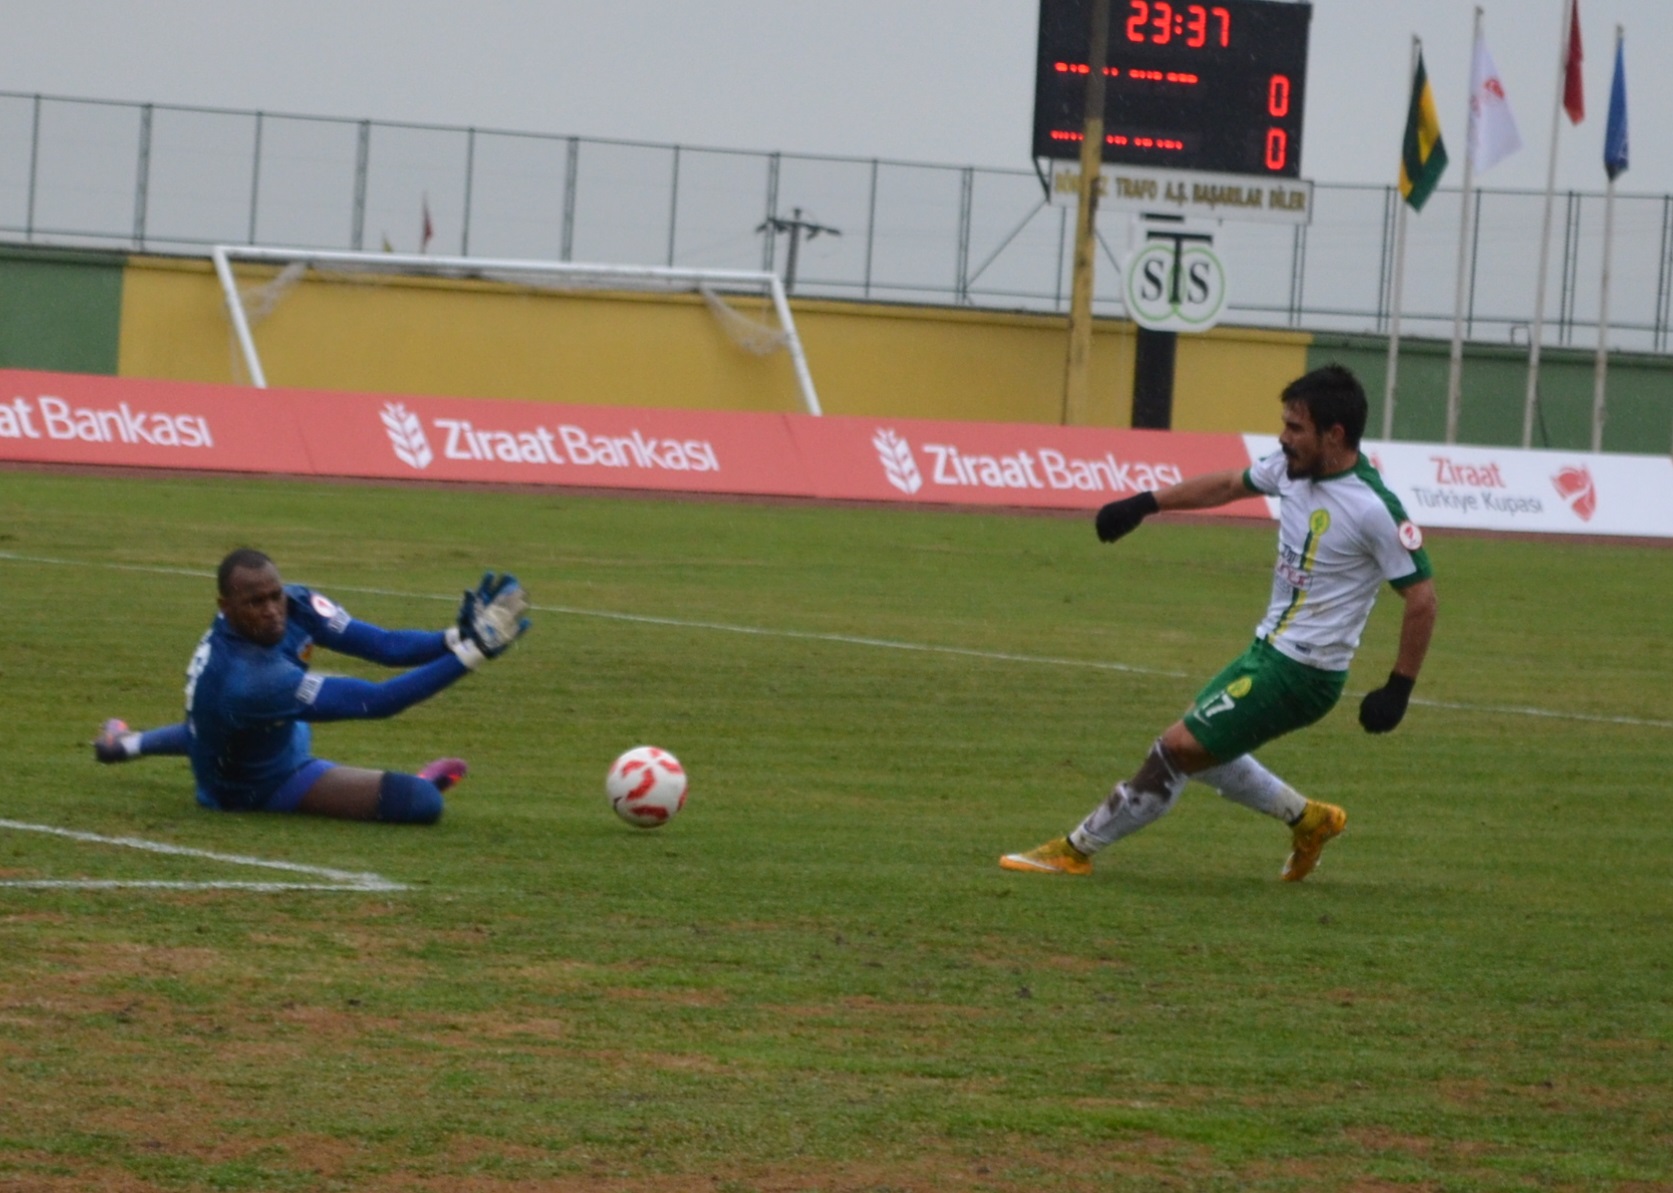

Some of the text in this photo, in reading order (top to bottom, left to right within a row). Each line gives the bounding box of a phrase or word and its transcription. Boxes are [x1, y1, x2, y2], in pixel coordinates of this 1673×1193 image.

[1126, 0, 1230, 47] 23:37
[1268, 75, 1290, 117] 0
[1265, 128, 1287, 170] 0
[1115, 176, 1159, 201] TRAFO
[37, 395, 215, 449] Bankası
[432, 417, 721, 473] Ziraat Bankası
[921, 442, 1046, 490] Ziraat
[1429, 455, 1507, 489] Ziraat
[1411, 486, 1544, 516] Türkiye Kupası
[1200, 688, 1236, 719] 17
